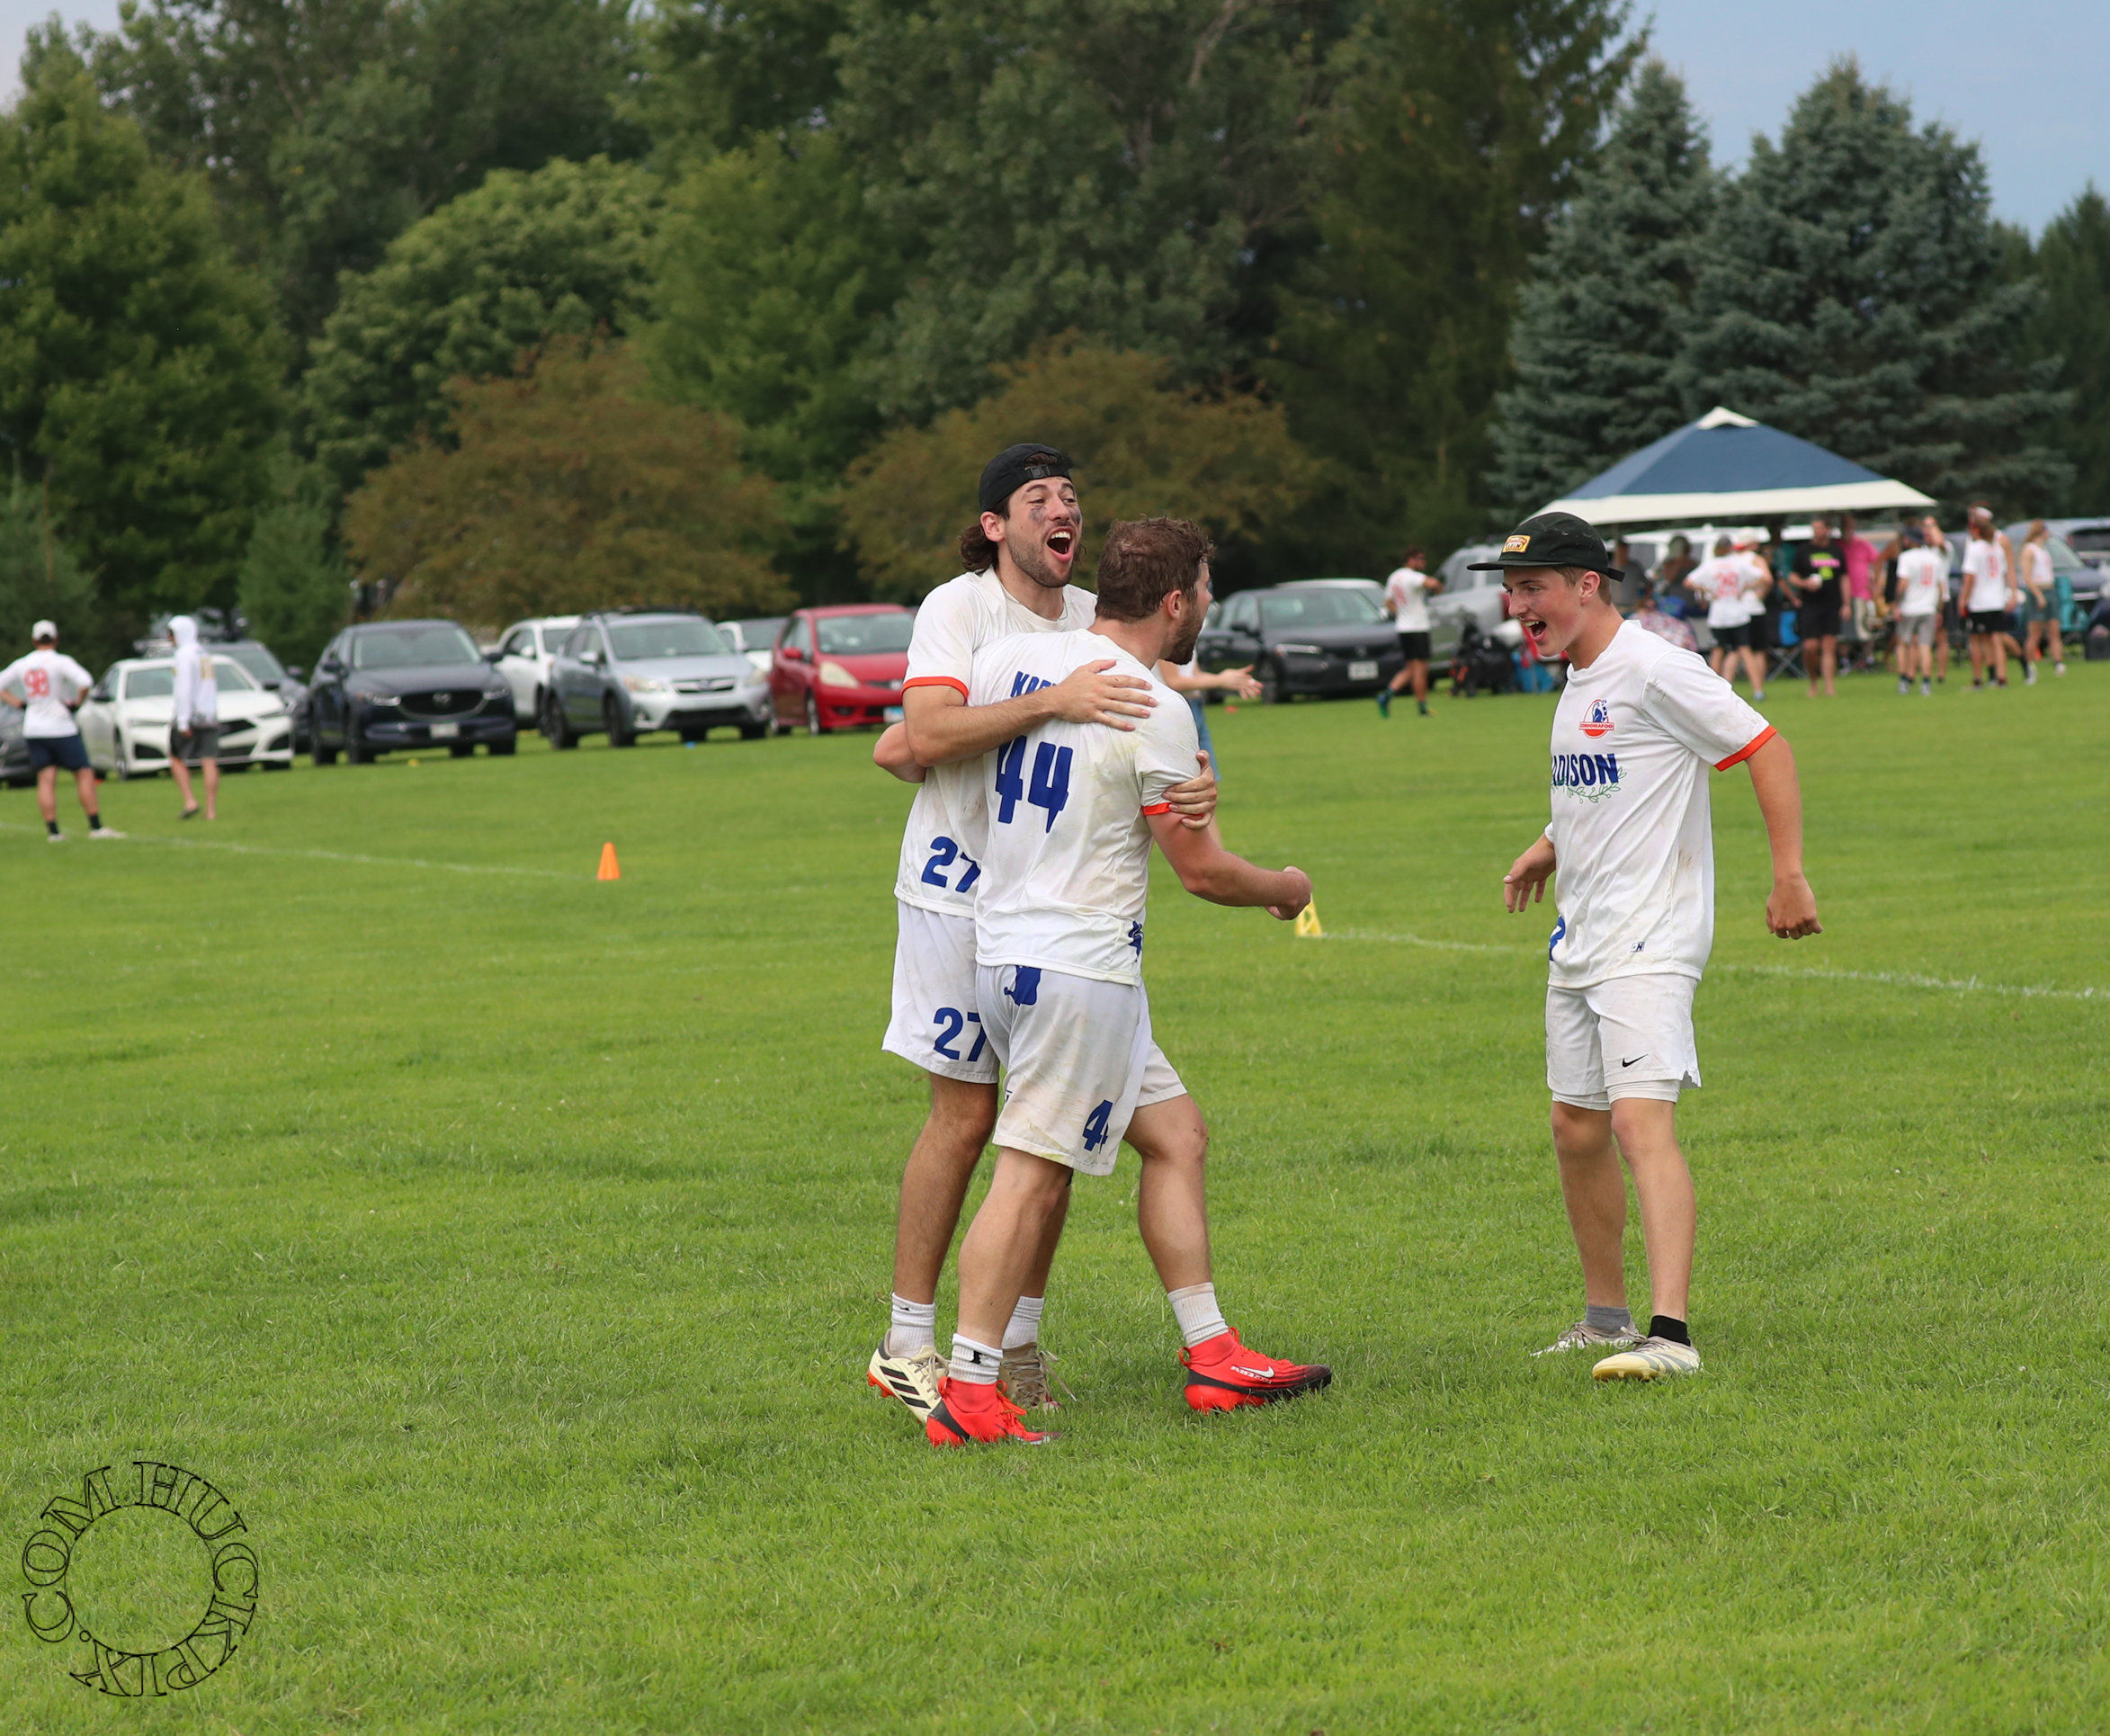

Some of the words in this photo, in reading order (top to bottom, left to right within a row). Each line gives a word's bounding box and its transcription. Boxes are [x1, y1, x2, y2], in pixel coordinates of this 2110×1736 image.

[995, 734, 1073, 833] 44
[921, 836, 981, 893] 27
[933, 1007, 987, 1062] 27
